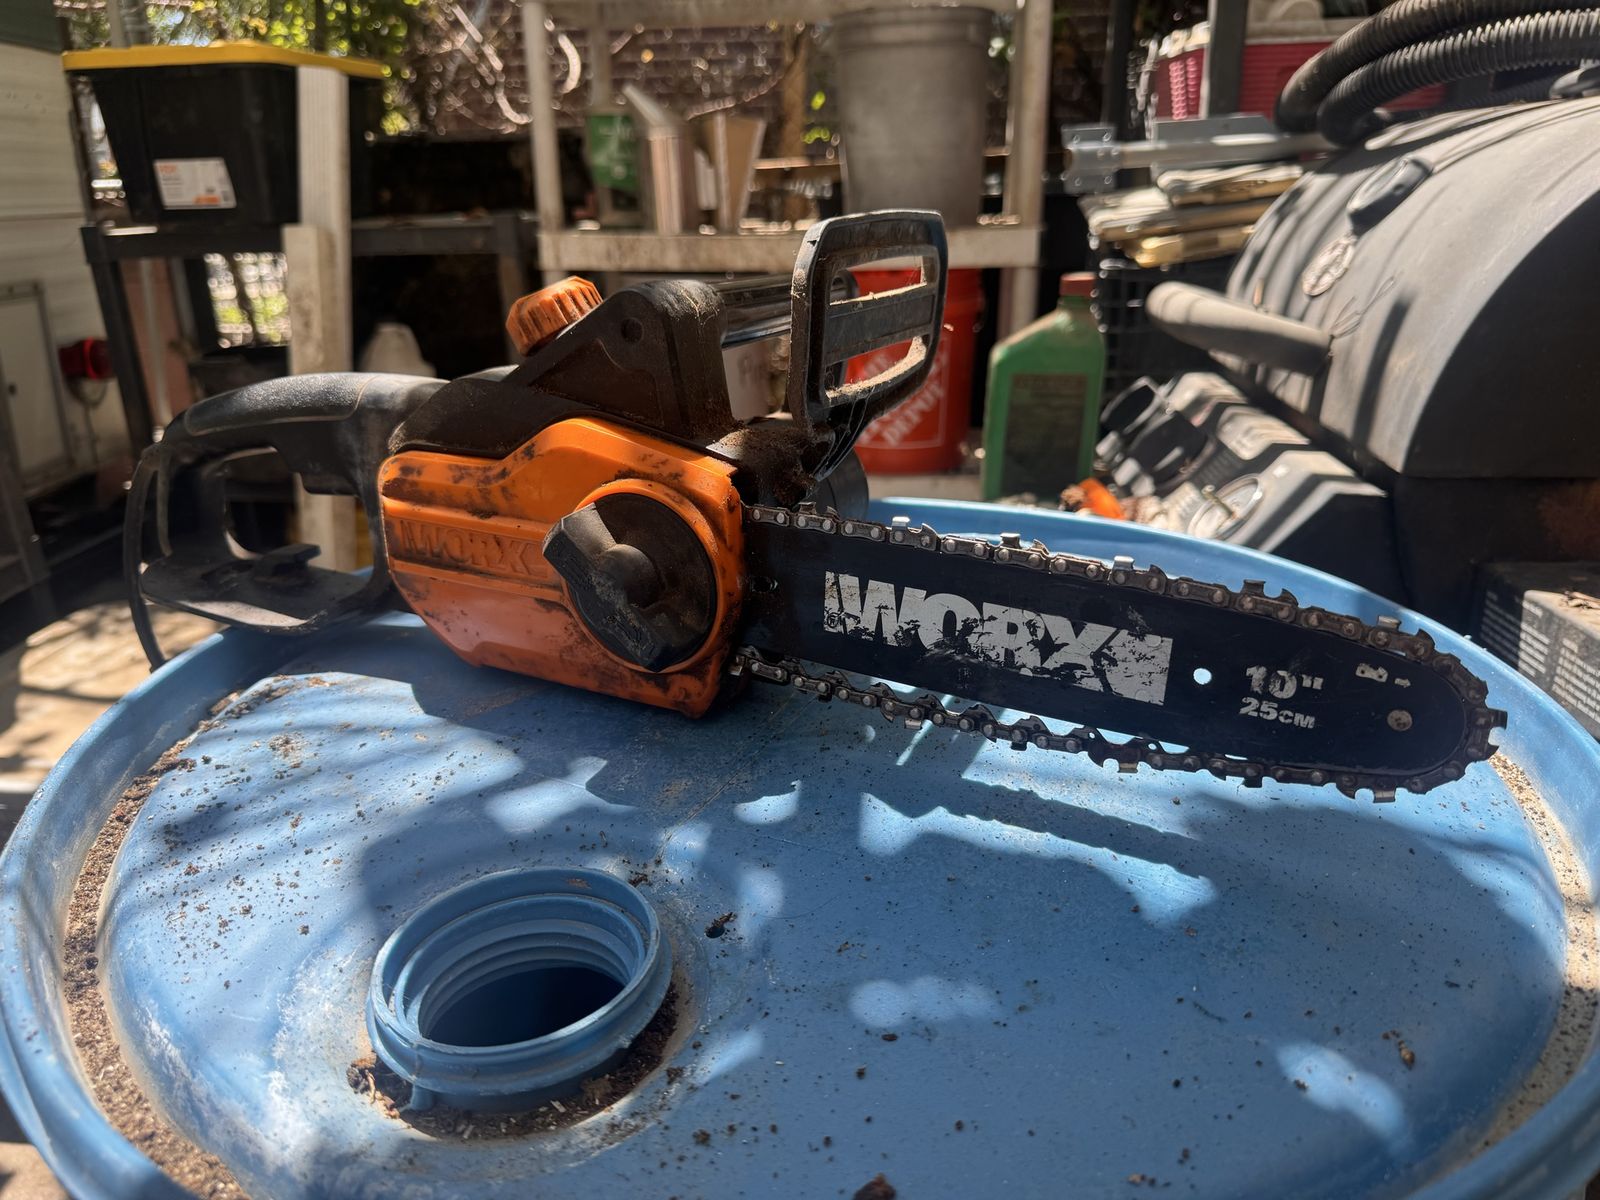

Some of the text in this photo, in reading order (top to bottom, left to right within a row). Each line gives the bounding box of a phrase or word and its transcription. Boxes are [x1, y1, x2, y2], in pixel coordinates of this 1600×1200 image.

[400, 519, 548, 577] WORX
[824, 571, 1172, 706] WORX
[1246, 665, 1324, 699] 10"
